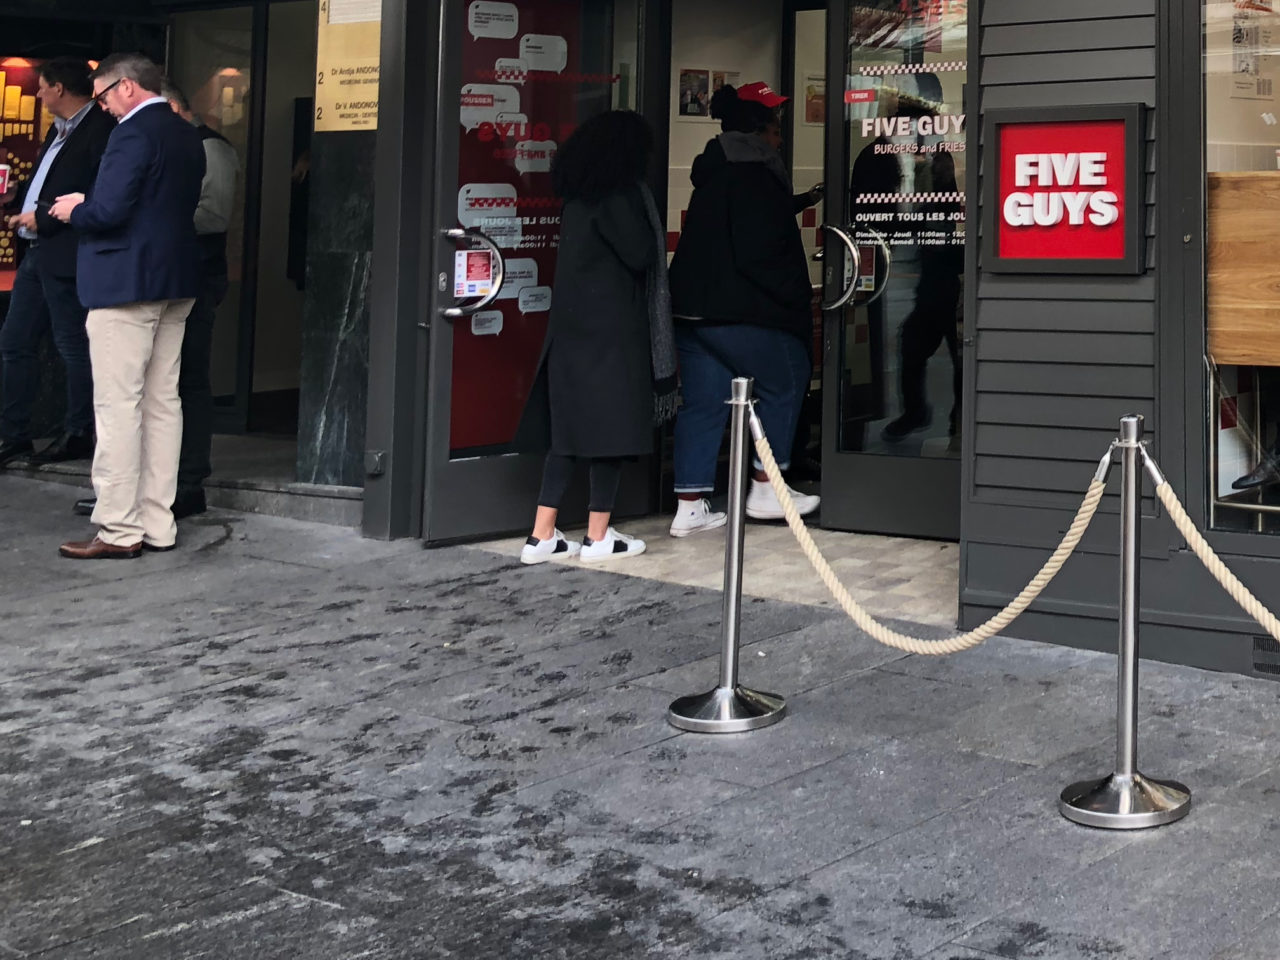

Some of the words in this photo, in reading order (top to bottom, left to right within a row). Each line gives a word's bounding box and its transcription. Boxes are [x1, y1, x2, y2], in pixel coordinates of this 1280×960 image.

[320, 1, 327, 14] 4
[318, 71, 324, 85] 2
[316, 106, 323, 120] 2
[861, 116, 911, 137] FIVE
[917, 114, 966, 136] GUY
[874, 143, 918, 154] BURGERS
[920, 144, 936, 153] and
[938, 141, 966, 152] FRIES
[1015, 152, 1108, 187] FIVE
[1003, 191, 1119, 227] GUYS
[855, 213, 894, 221] OUVERT
[897, 212, 924, 221] TOUS
[926, 212, 945, 221] LES
